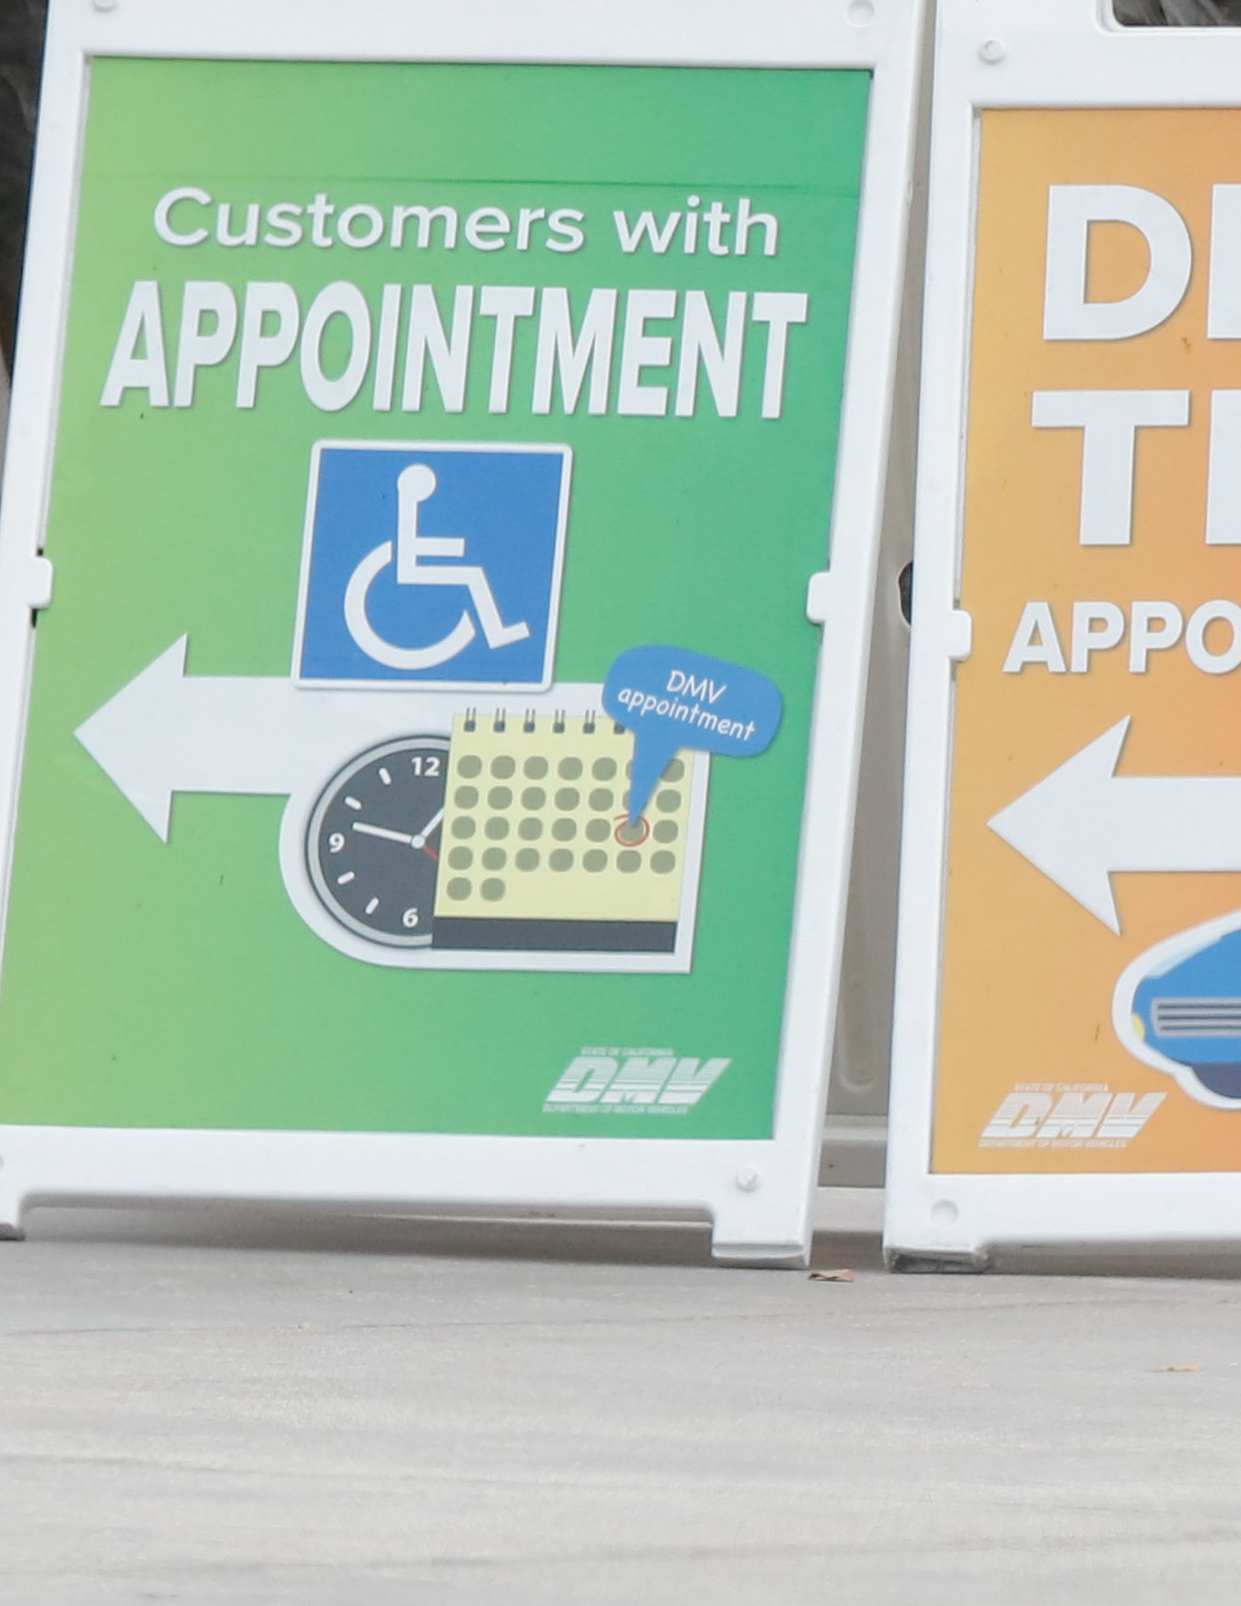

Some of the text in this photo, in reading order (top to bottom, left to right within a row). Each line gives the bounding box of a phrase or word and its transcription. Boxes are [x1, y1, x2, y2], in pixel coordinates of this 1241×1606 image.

[154, 187, 780, 257] Customers with
[100, 280, 808, 419] APPOINTMENT
[1002, 600, 1241, 675] APPO
[666, 669, 728, 705] DMV
[617, 688, 756, 742] appointment
[411, 757, 440, 777] 12
[329, 832, 346, 853] 9
[402, 908, 419, 927] 6
[545, 1055, 732, 1105] DMV
[981, 1092, 1169, 1139] DMV
